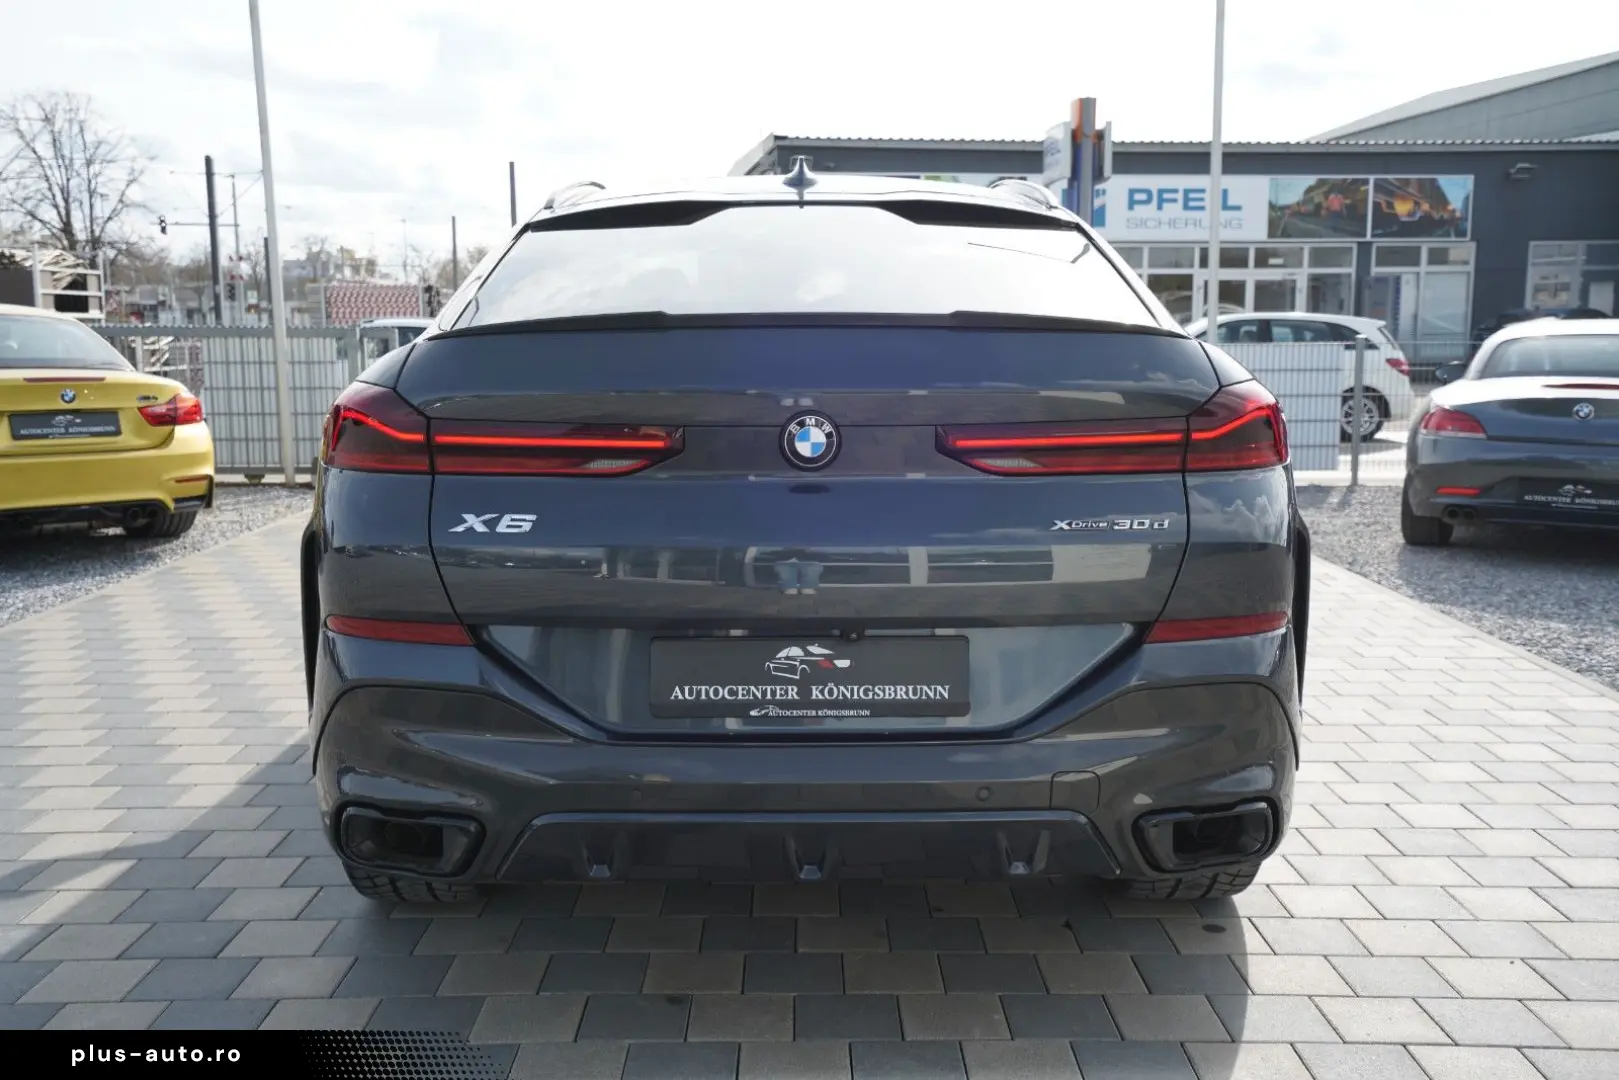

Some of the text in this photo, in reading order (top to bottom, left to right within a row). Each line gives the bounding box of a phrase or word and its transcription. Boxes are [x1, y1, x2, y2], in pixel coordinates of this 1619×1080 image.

[1127, 187, 1243, 212] PFEL
[789, 417, 833, 435] BMW
[447, 513, 537, 533] X6
[670, 682, 950, 700] AUTOCENTER KÖNIGSBRUNN
[768, 707, 871, 717] AUTOCENTER KÖNIGSBRUNN
